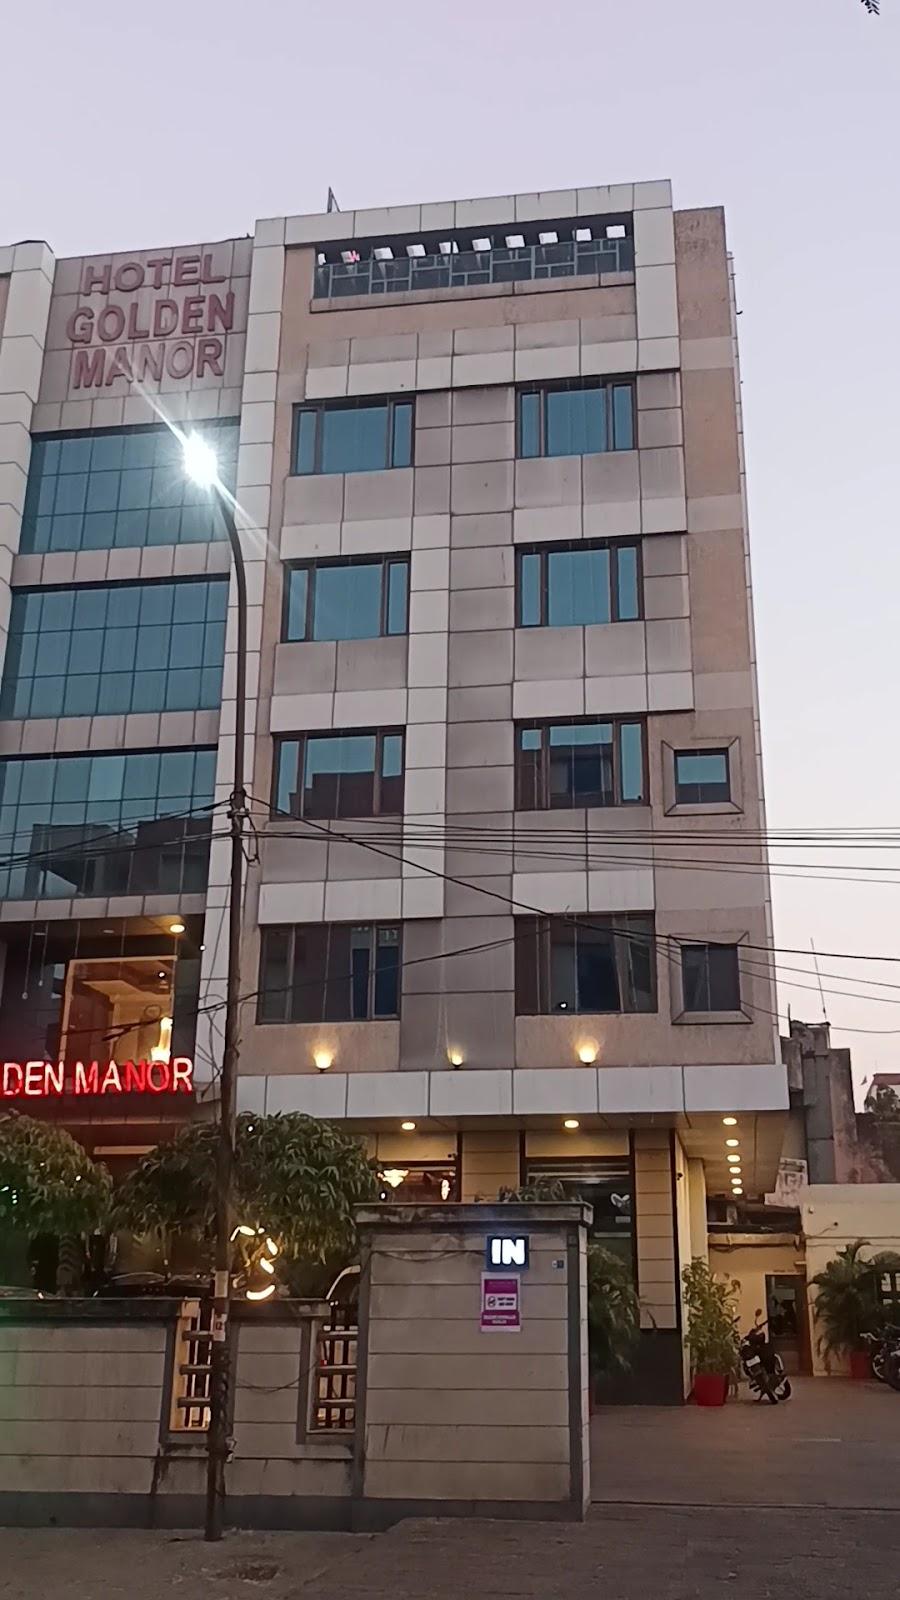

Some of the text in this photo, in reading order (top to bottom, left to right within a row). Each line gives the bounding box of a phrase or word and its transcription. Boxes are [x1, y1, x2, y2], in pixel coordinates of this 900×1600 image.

[84, 255, 226, 296] HOTEL
[67, 292, 235, 344] GOLDEN
[74, 339, 224, 389] MANOR
[3, 1057, 193, 1095] DEN MANOR
[491, 1238, 526, 1265] IN
